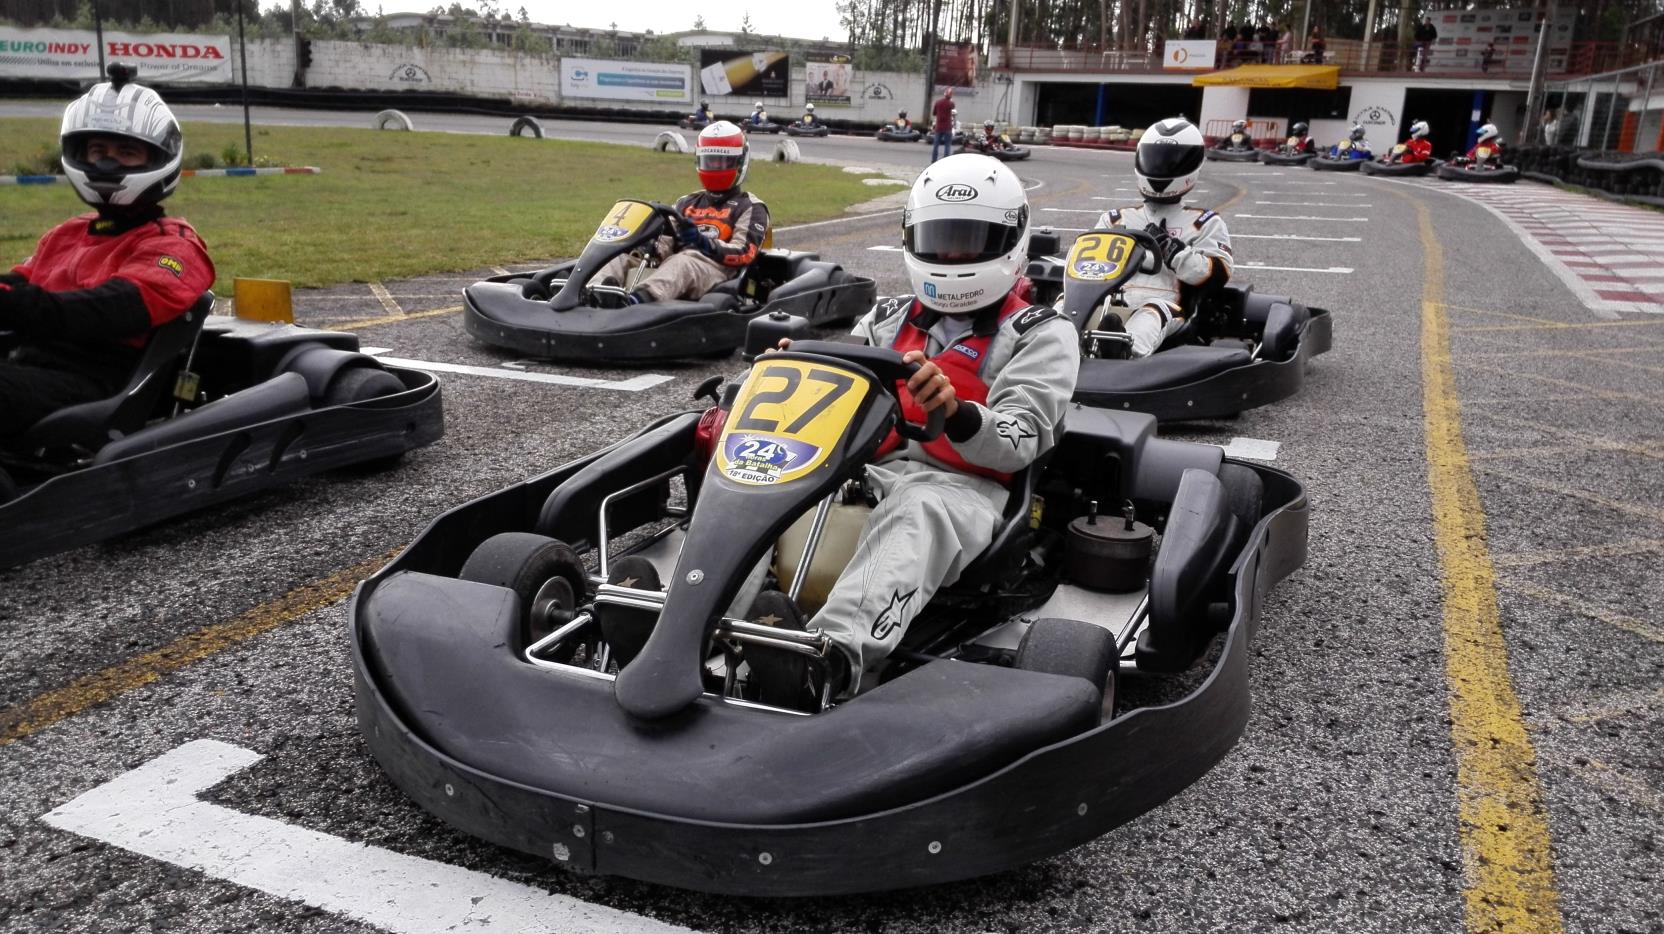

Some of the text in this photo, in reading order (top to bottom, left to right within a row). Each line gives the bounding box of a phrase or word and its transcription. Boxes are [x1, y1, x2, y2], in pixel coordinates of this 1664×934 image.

[107, 42, 224, 59] HONDA
[938, 185, 974, 197] Arai
[612, 203, 633, 226] 4
[1076, 236, 1126, 263] 26
[937, 289, 984, 301] METALPEDRO
[734, 365, 856, 435] 27
[739, 440, 777, 460] 24
[734, 458, 778, 471] da Batalha
[741, 472, 775, 483] EDIÇÃO
